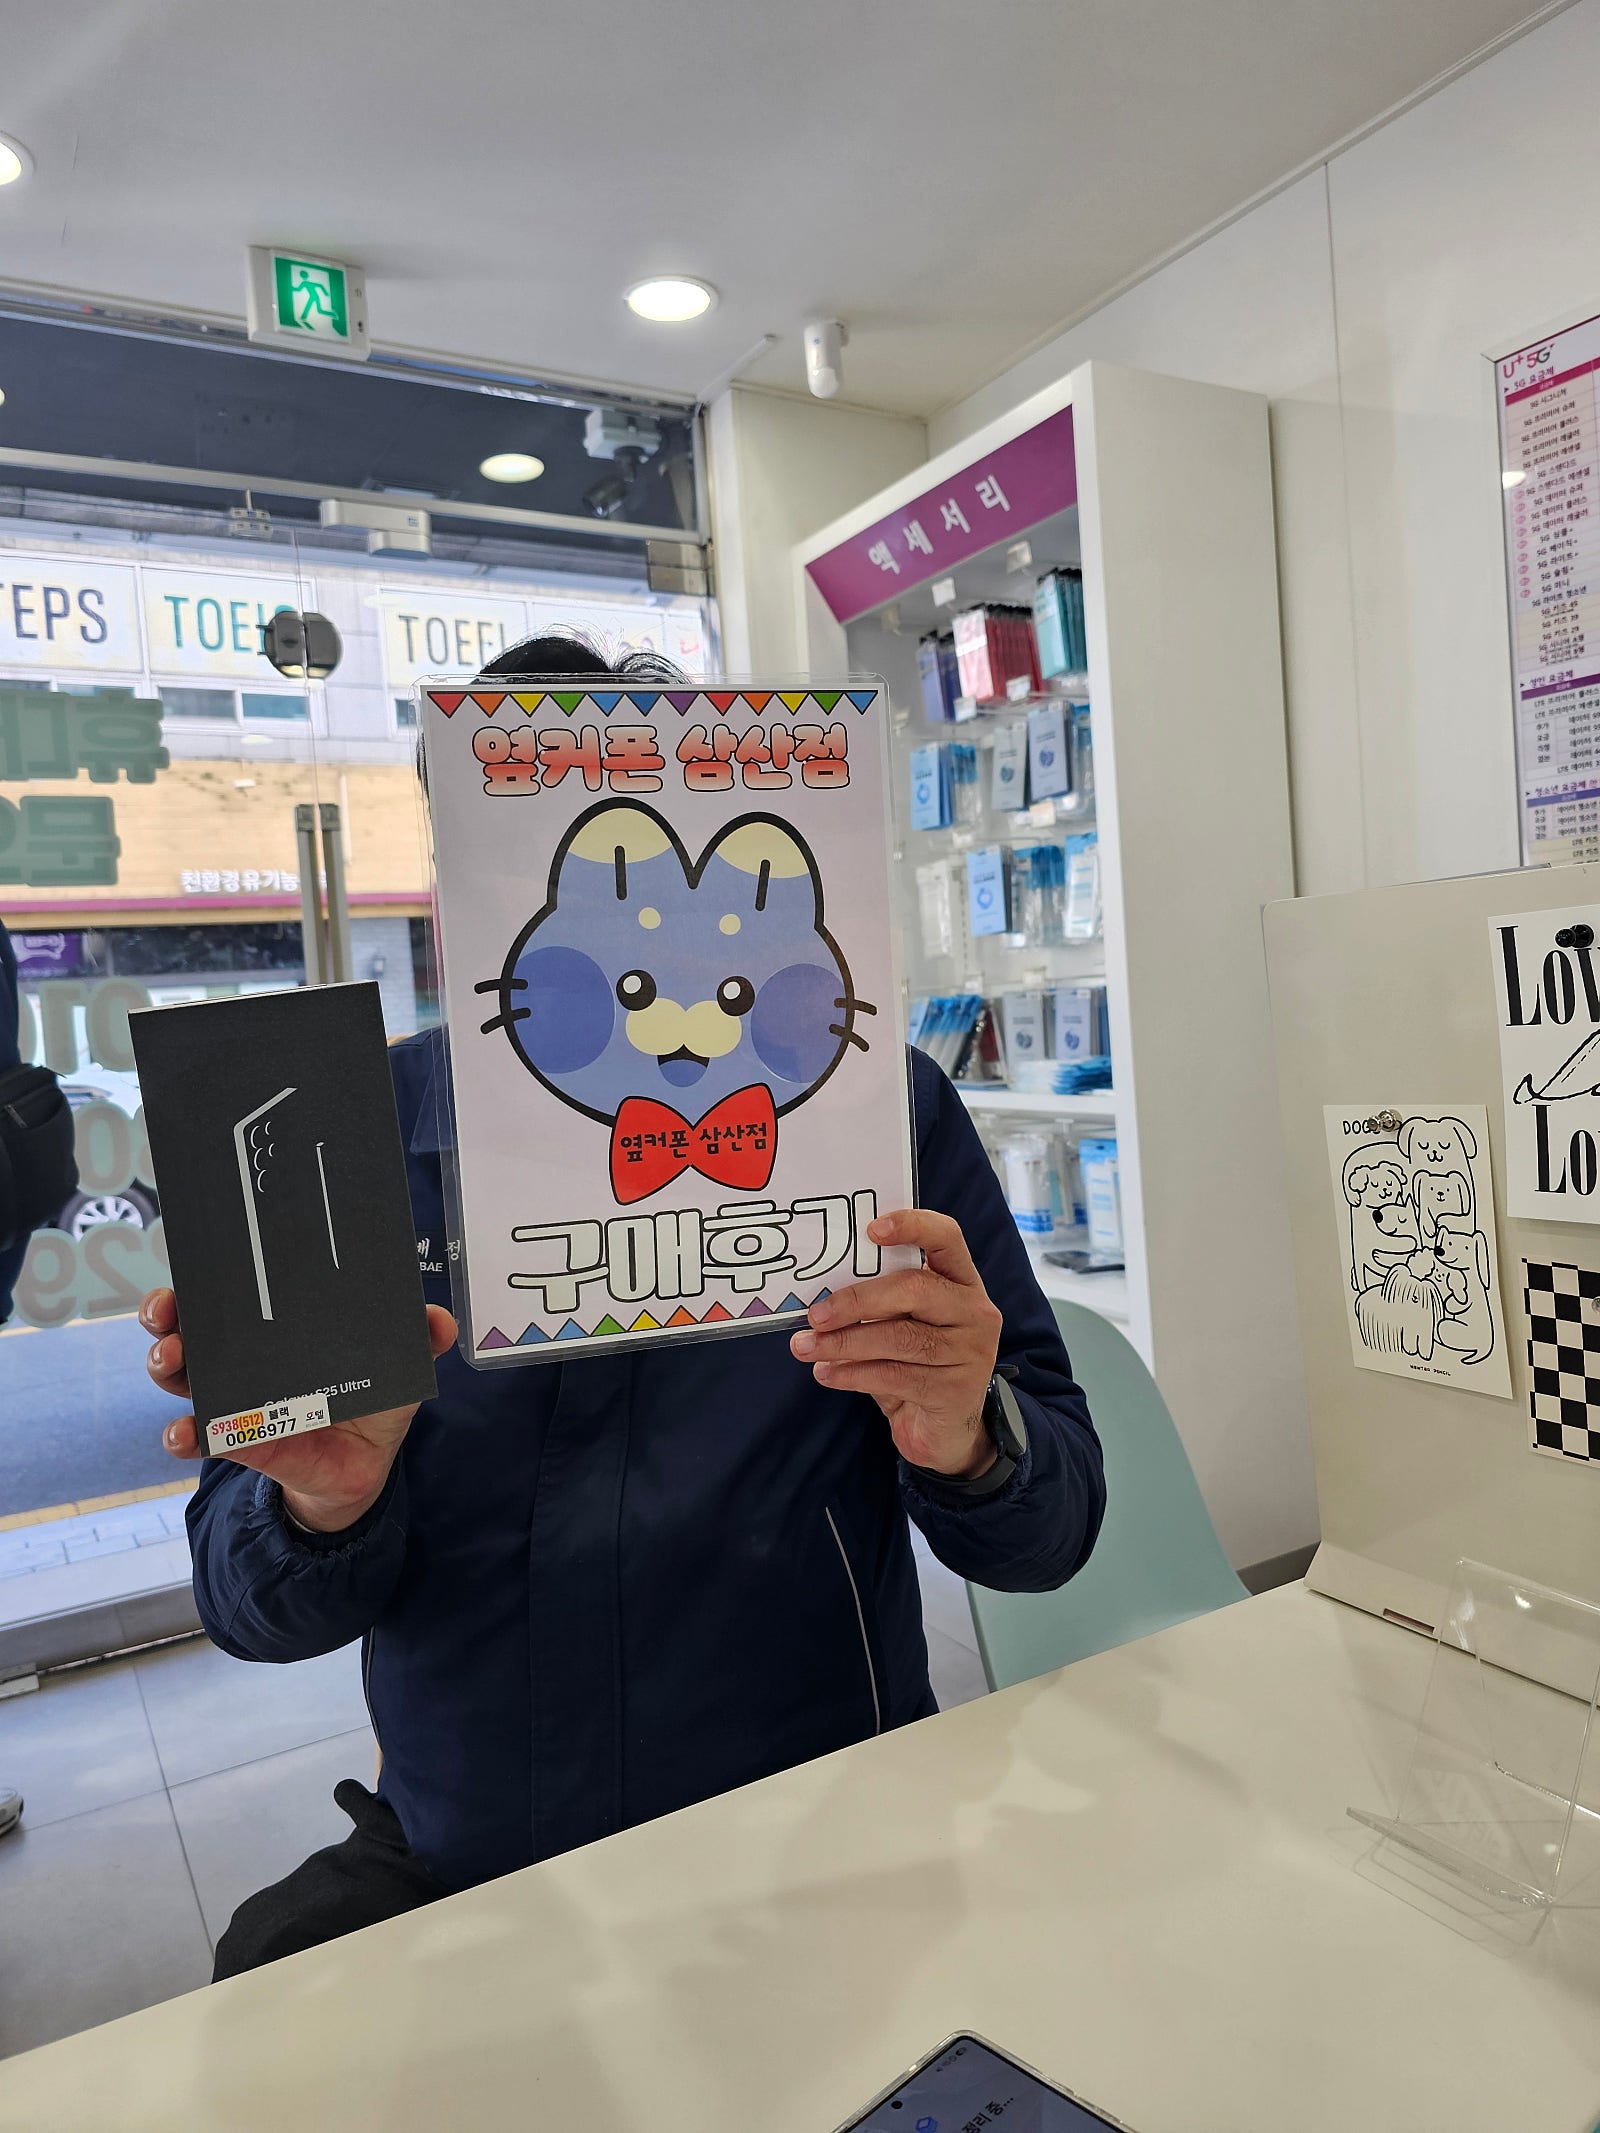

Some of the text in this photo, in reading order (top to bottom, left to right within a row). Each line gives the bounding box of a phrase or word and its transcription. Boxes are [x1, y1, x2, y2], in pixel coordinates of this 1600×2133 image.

[1503, 346, 1550, 378] U+ 5G
[163, 594, 296, 653] TOEI
[472, 722, 850, 797] 옆커폰 삼산점
[620, 1122, 767, 1163] 옆커폰 삼산점
[419, 1261, 444, 1272] BAE
[508, 1188, 882, 1315] 구매후기
[340, 1377, 372, 1394] Ultra
[211, 1406, 290, 1436] S938(512) 블랙
[225, 1417, 298, 1447] 0026977
